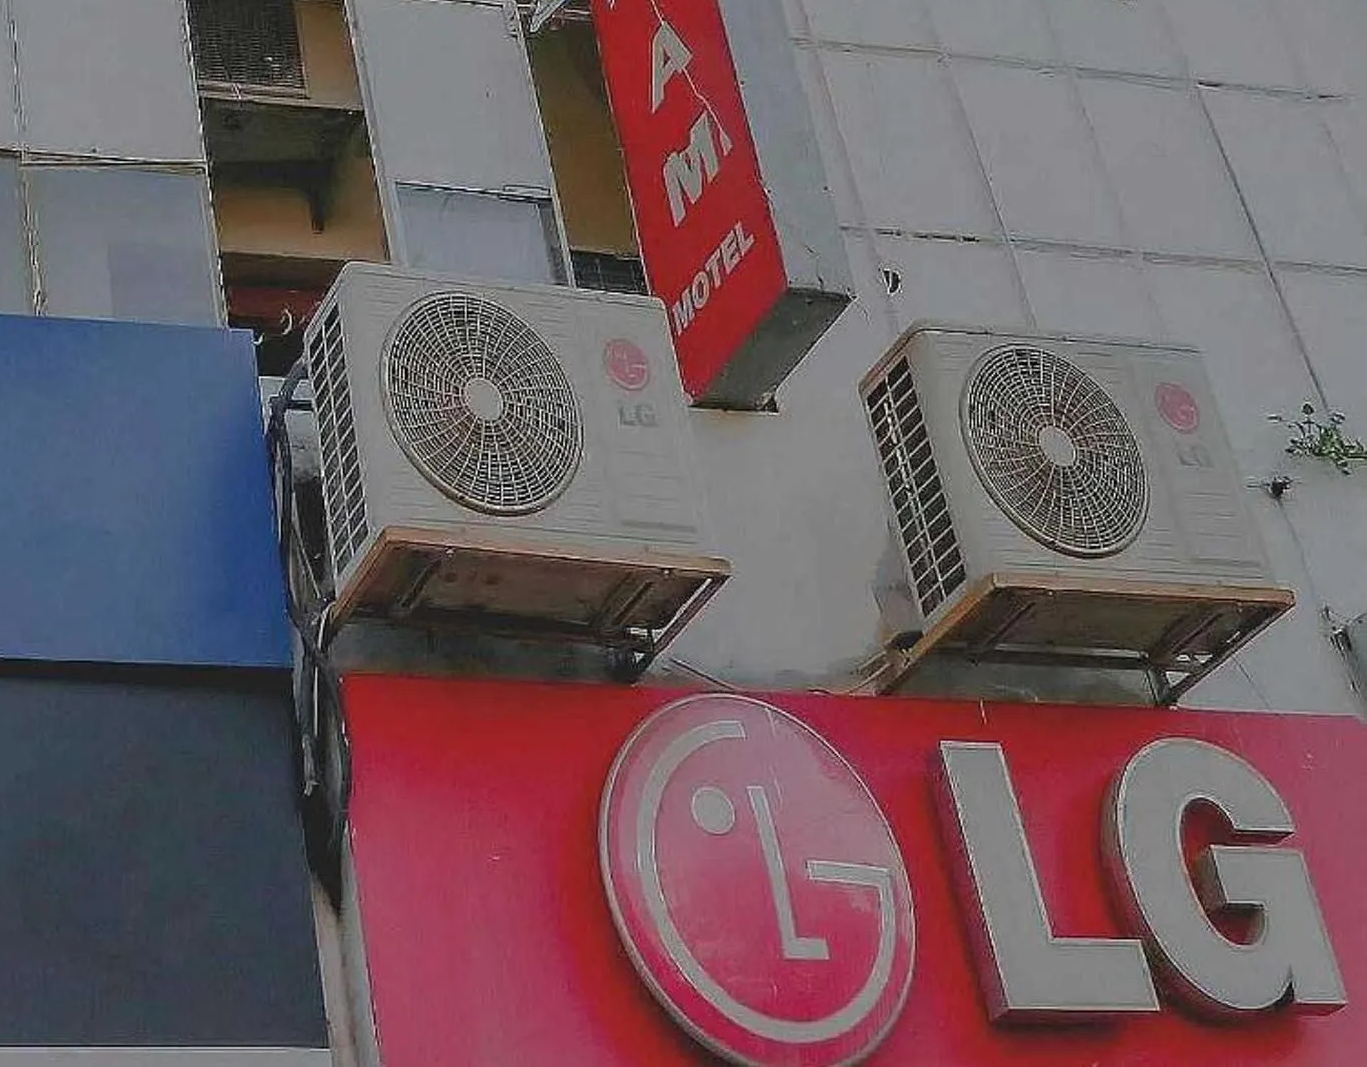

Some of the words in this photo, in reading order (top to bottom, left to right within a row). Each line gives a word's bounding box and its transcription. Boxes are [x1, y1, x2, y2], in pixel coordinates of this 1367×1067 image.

[672, 221, 755, 336] MOTEL
[619, 403, 657, 427] LG
[936, 737, 1348, 1015] LG
